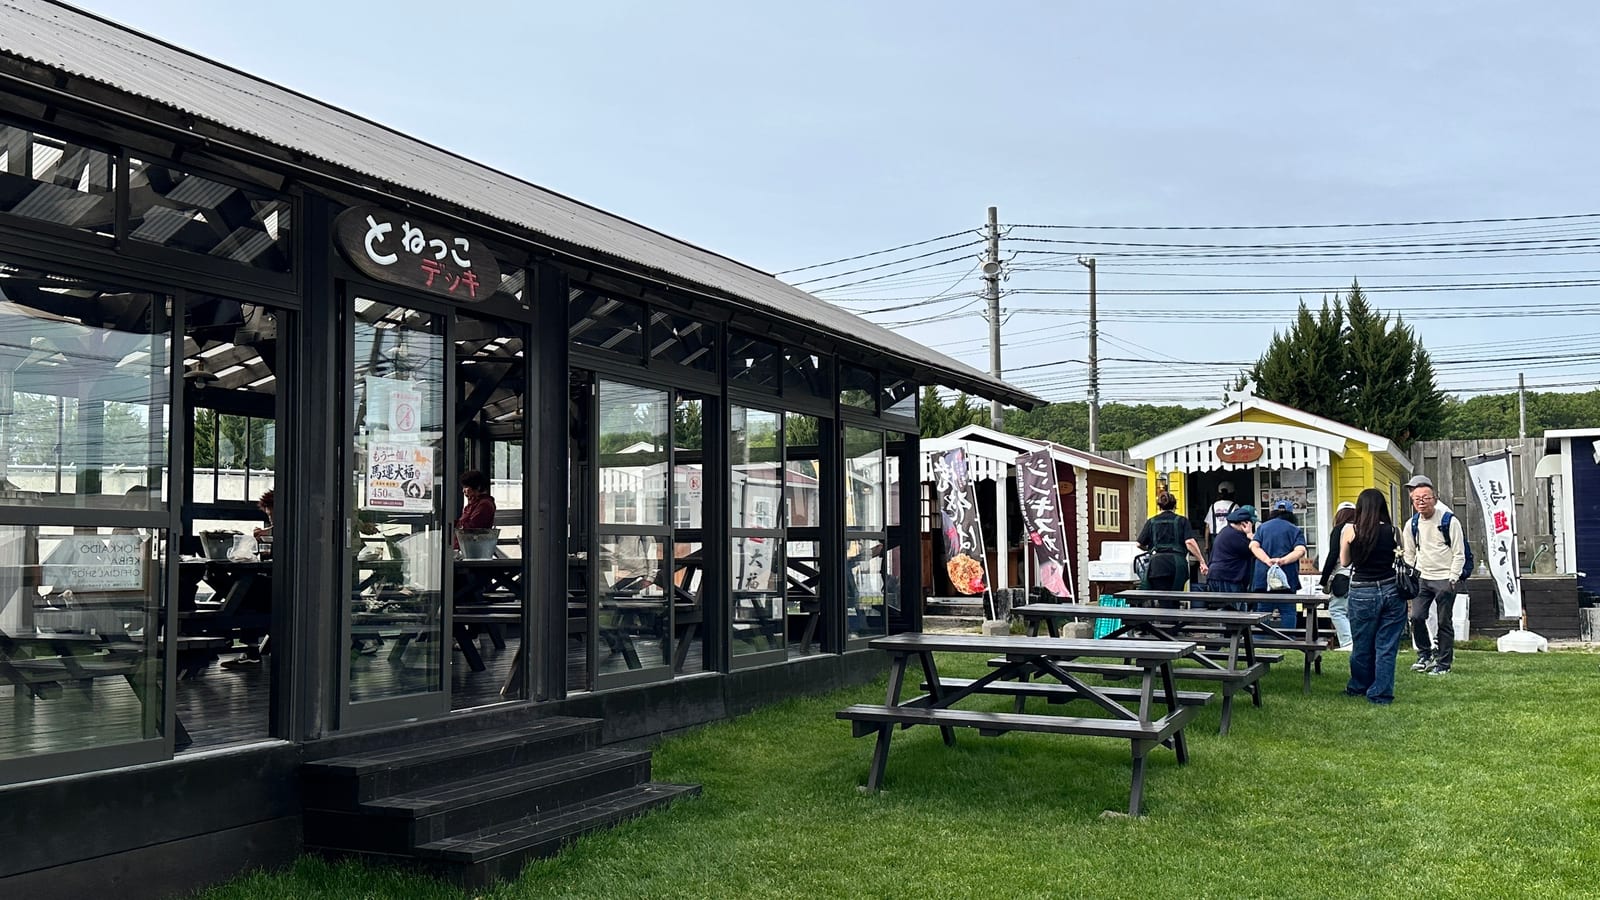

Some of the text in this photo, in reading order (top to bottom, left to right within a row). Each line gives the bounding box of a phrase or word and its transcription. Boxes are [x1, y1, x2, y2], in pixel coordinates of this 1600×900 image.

[364, 214, 472, 268] とねっこ
[420, 258, 480, 298] デッキ
